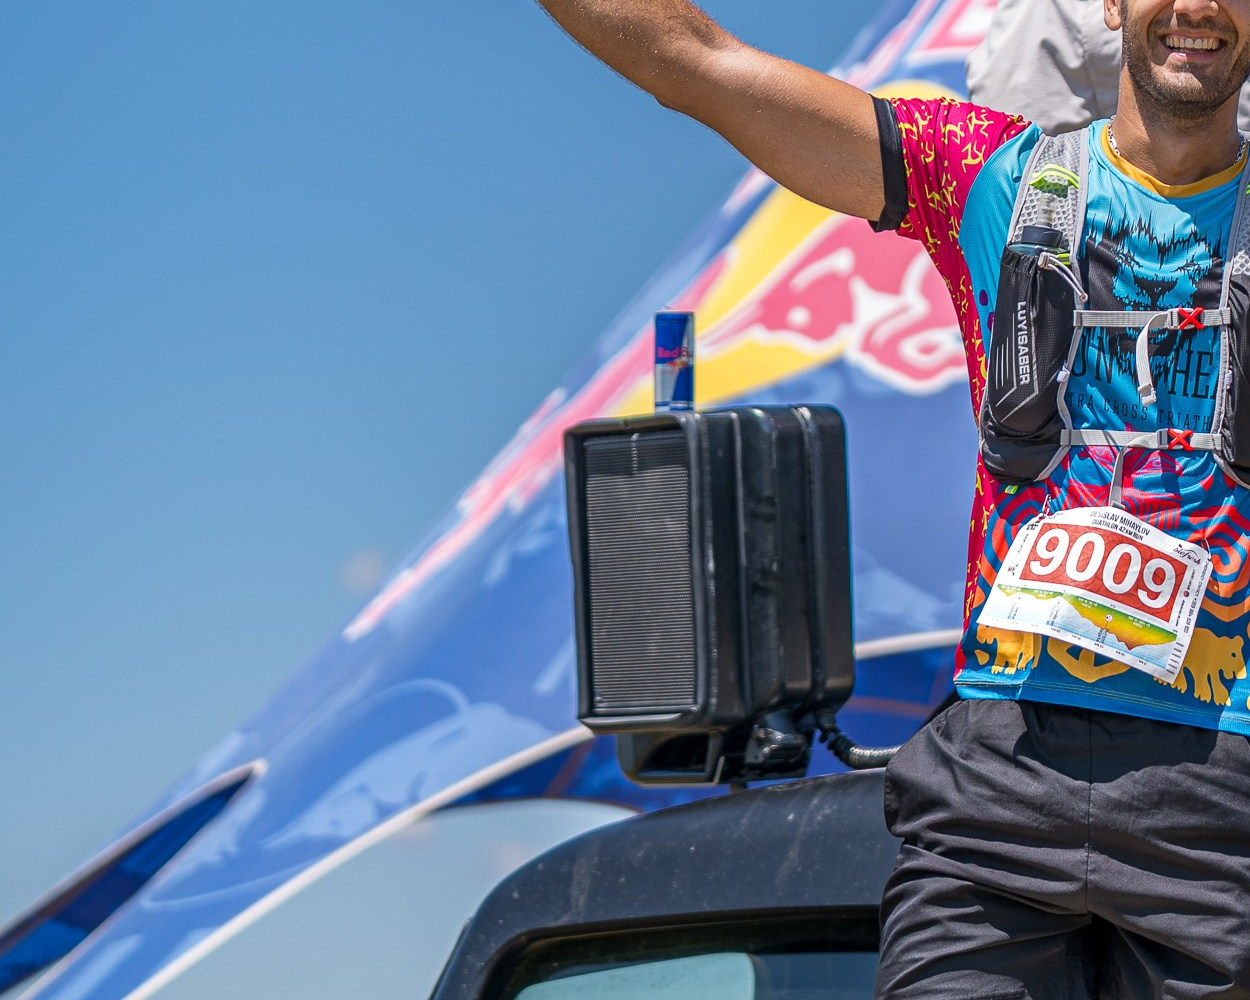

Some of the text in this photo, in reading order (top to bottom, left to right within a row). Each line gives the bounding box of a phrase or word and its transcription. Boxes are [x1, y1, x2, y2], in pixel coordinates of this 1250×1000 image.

[657, 347, 679, 358] Red
[1017, 301, 1030, 386] LUYISABER
[1103, 397, 1148, 421] CROSS
[1119, 516, 1151, 536] MIHAYLOV
[1031, 527, 1176, 609] 9009
